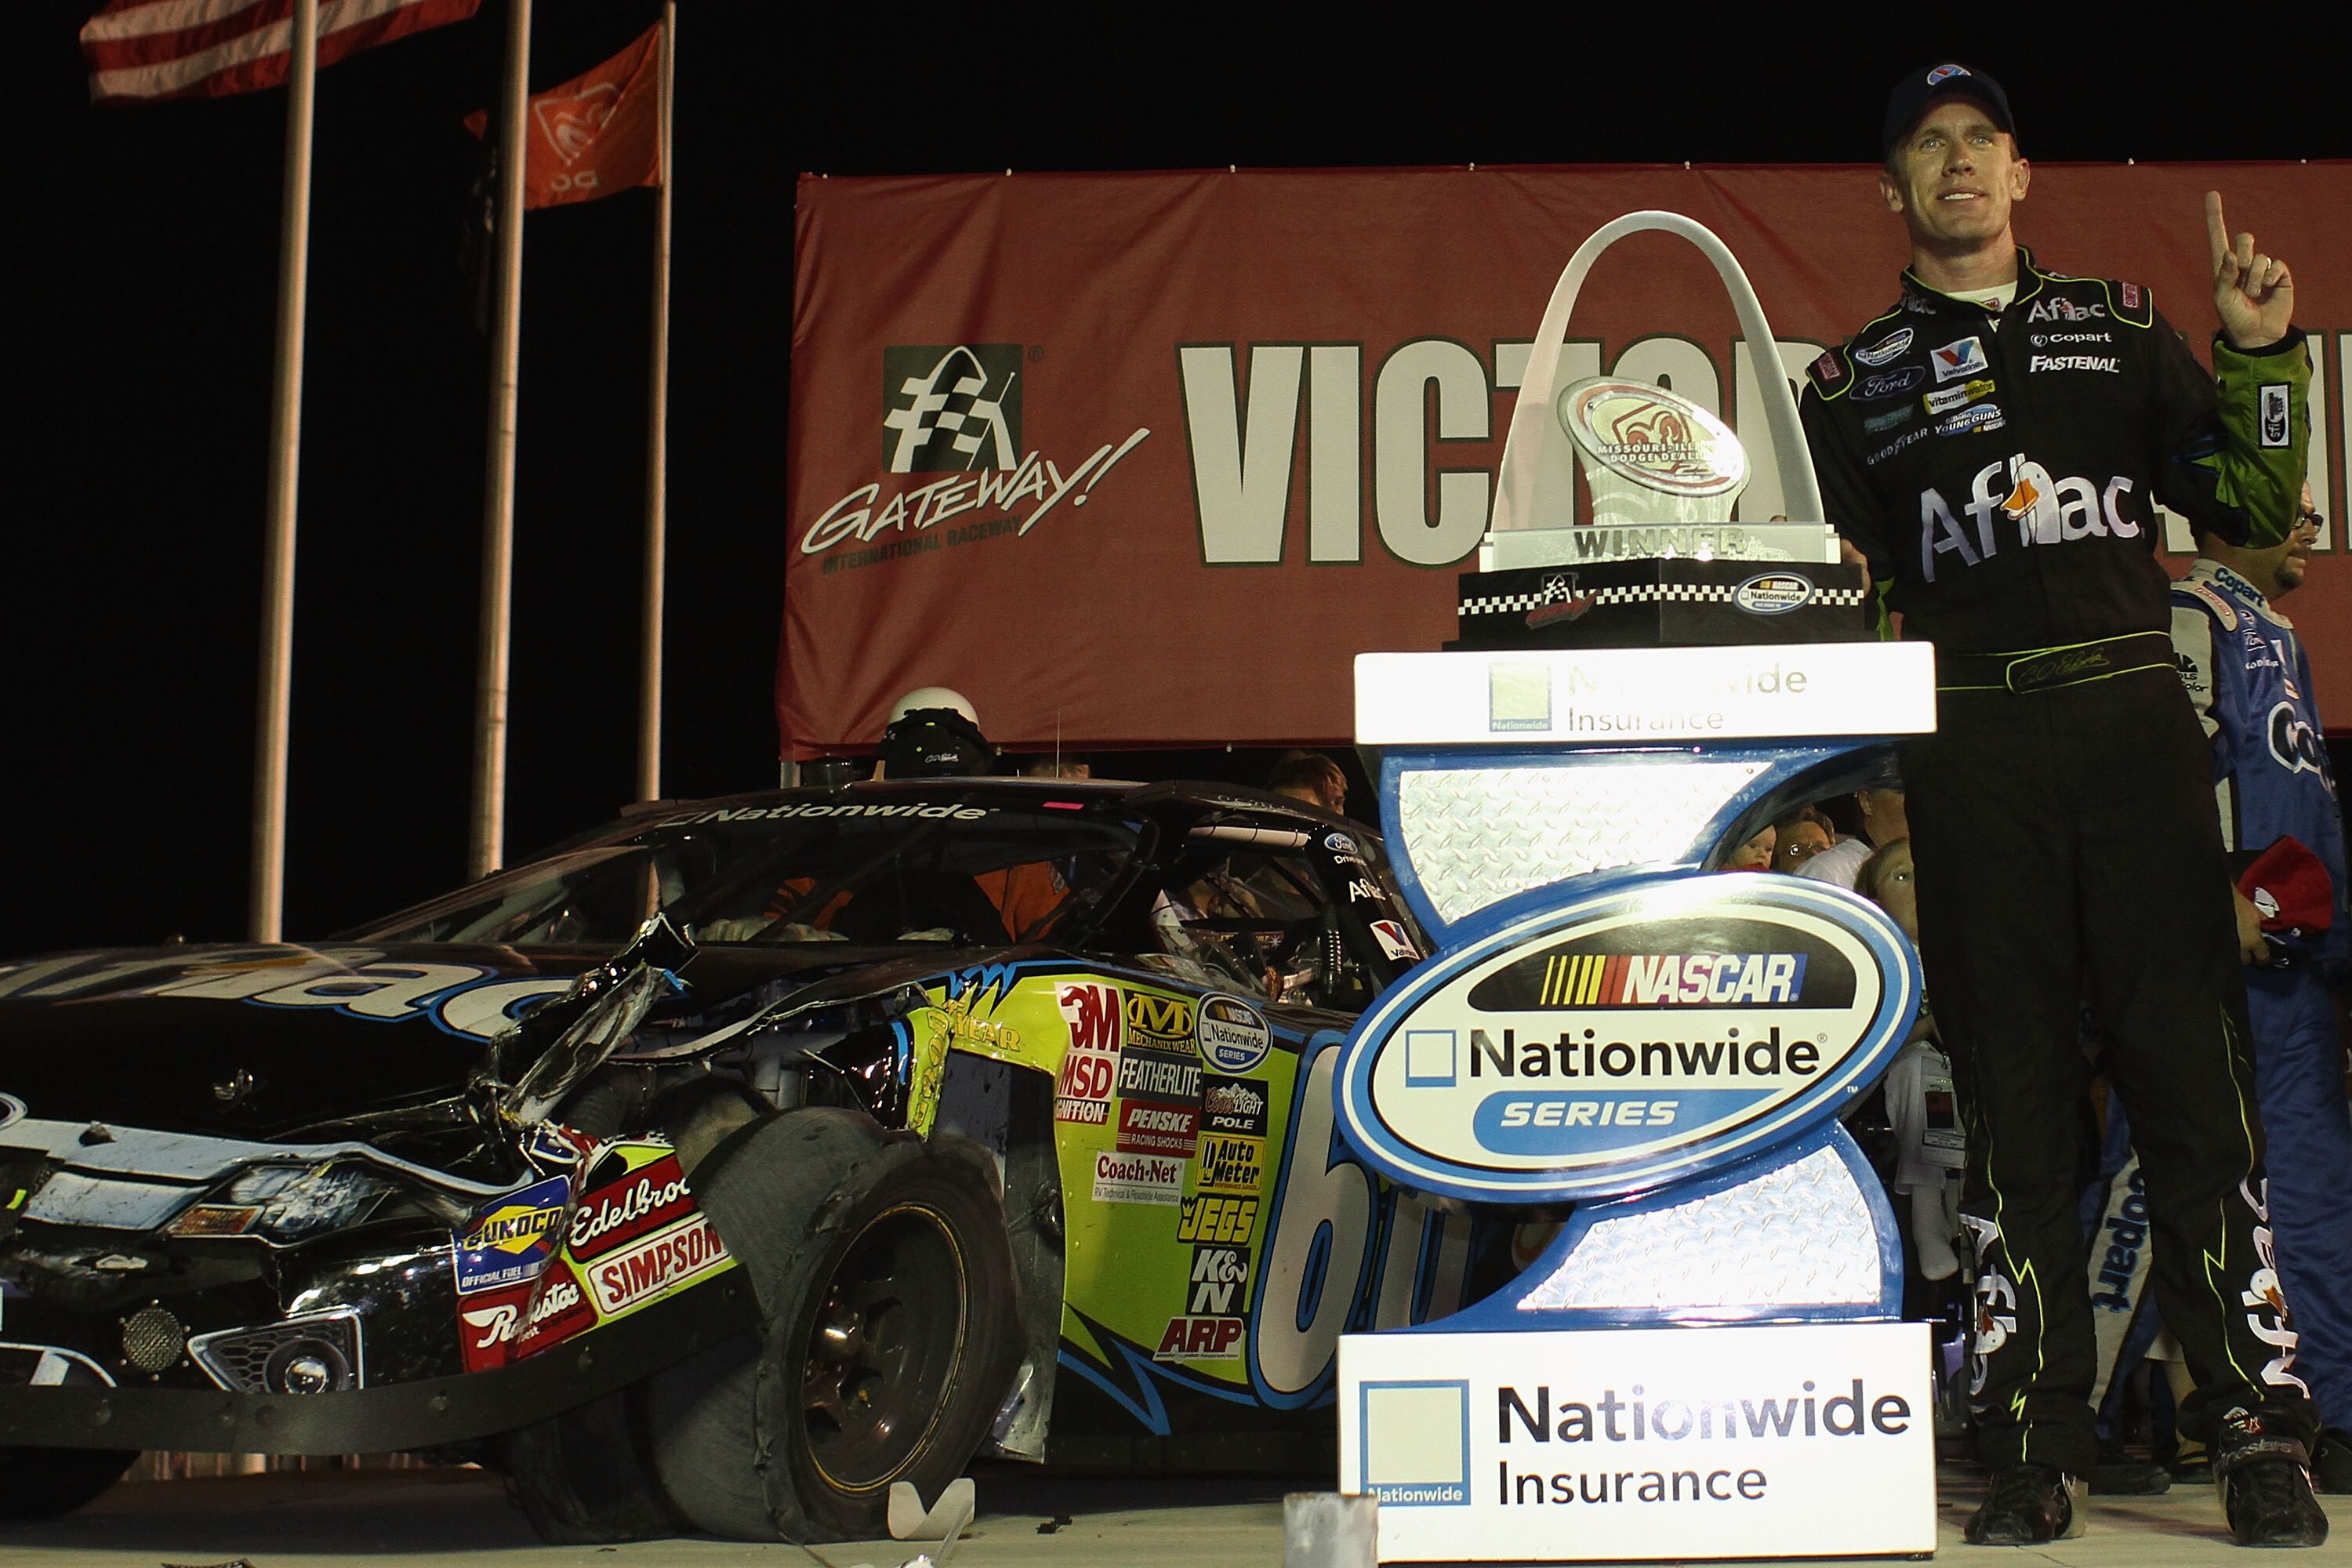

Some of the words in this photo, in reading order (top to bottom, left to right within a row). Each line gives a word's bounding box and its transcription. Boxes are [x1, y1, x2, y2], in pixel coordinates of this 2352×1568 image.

[2027, 297, 2105, 323] Aflac
[2050, 332, 2112, 343] Copart
[2029, 355, 2119, 373] FASTENAL
[1864, 372, 1911, 397] Ford
[1928, 381, 1994, 408] vitaminwater
[1175, 337, 1835, 568] VICTOR
[1610, 453, 1639, 463] DODGE
[1920, 452, 2140, 583] Aflac
[823, 532, 941, 575] INTERNATIONAL
[947, 514, 1022, 547] RACEWAY
[1573, 528, 1748, 557] WINNER
[1751, 591, 1801, 601] Nationwide
[2215, 568, 2265, 608] Copart
[1570, 709, 1723, 731] Insurance
[697, 801, 988, 825] Nationwide
[1621, 956, 1798, 1004] NASCAR
[1061, 985, 1118, 1052] 3M
[1127, 1029, 1171, 1050] MECHANIX
[1172, 1036, 1196, 1054] WEAR
[1211, 1022, 1264, 1049] Nationwide
[1218, 1050, 1246, 1062] SERIES
[1470, 1028, 1820, 1078] Nationwide
[1059, 1056, 1114, 1099] MSD
[1119, 1058, 1202, 1098] FEATHERLITE
[1058, 1100, 1105, 1123] GNITION
[1234, 1097, 1265, 1116] LIGHT
[1501, 1102, 1679, 1127] SERIES
[1127, 1108, 1193, 1134] PENSKE
[1212, 1116, 1254, 1130] POLE
[1131, 1134, 1154, 1145] RACING
[1156, 1137, 1183, 1149] SHOCKS
[1217, 1139, 1254, 1163] Auto
[1097, 1155, 1177, 1183] Coach-Net
[1214, 1161, 1260, 1184] Meter
[569, 1178, 690, 1247] Edelbroc
[1178, 1197, 1257, 1243] JEGS
[461, 1271, 499, 1287] OFFICIAL
[502, 1267, 522, 1279] FUEL
[601, 1225, 722, 1303] SIMPSON
[1158, 1319, 1242, 1352] ARP
[1499, 1381, 1910, 1444] Nationwide
[1501, 1460, 1767, 1505] Insurance
